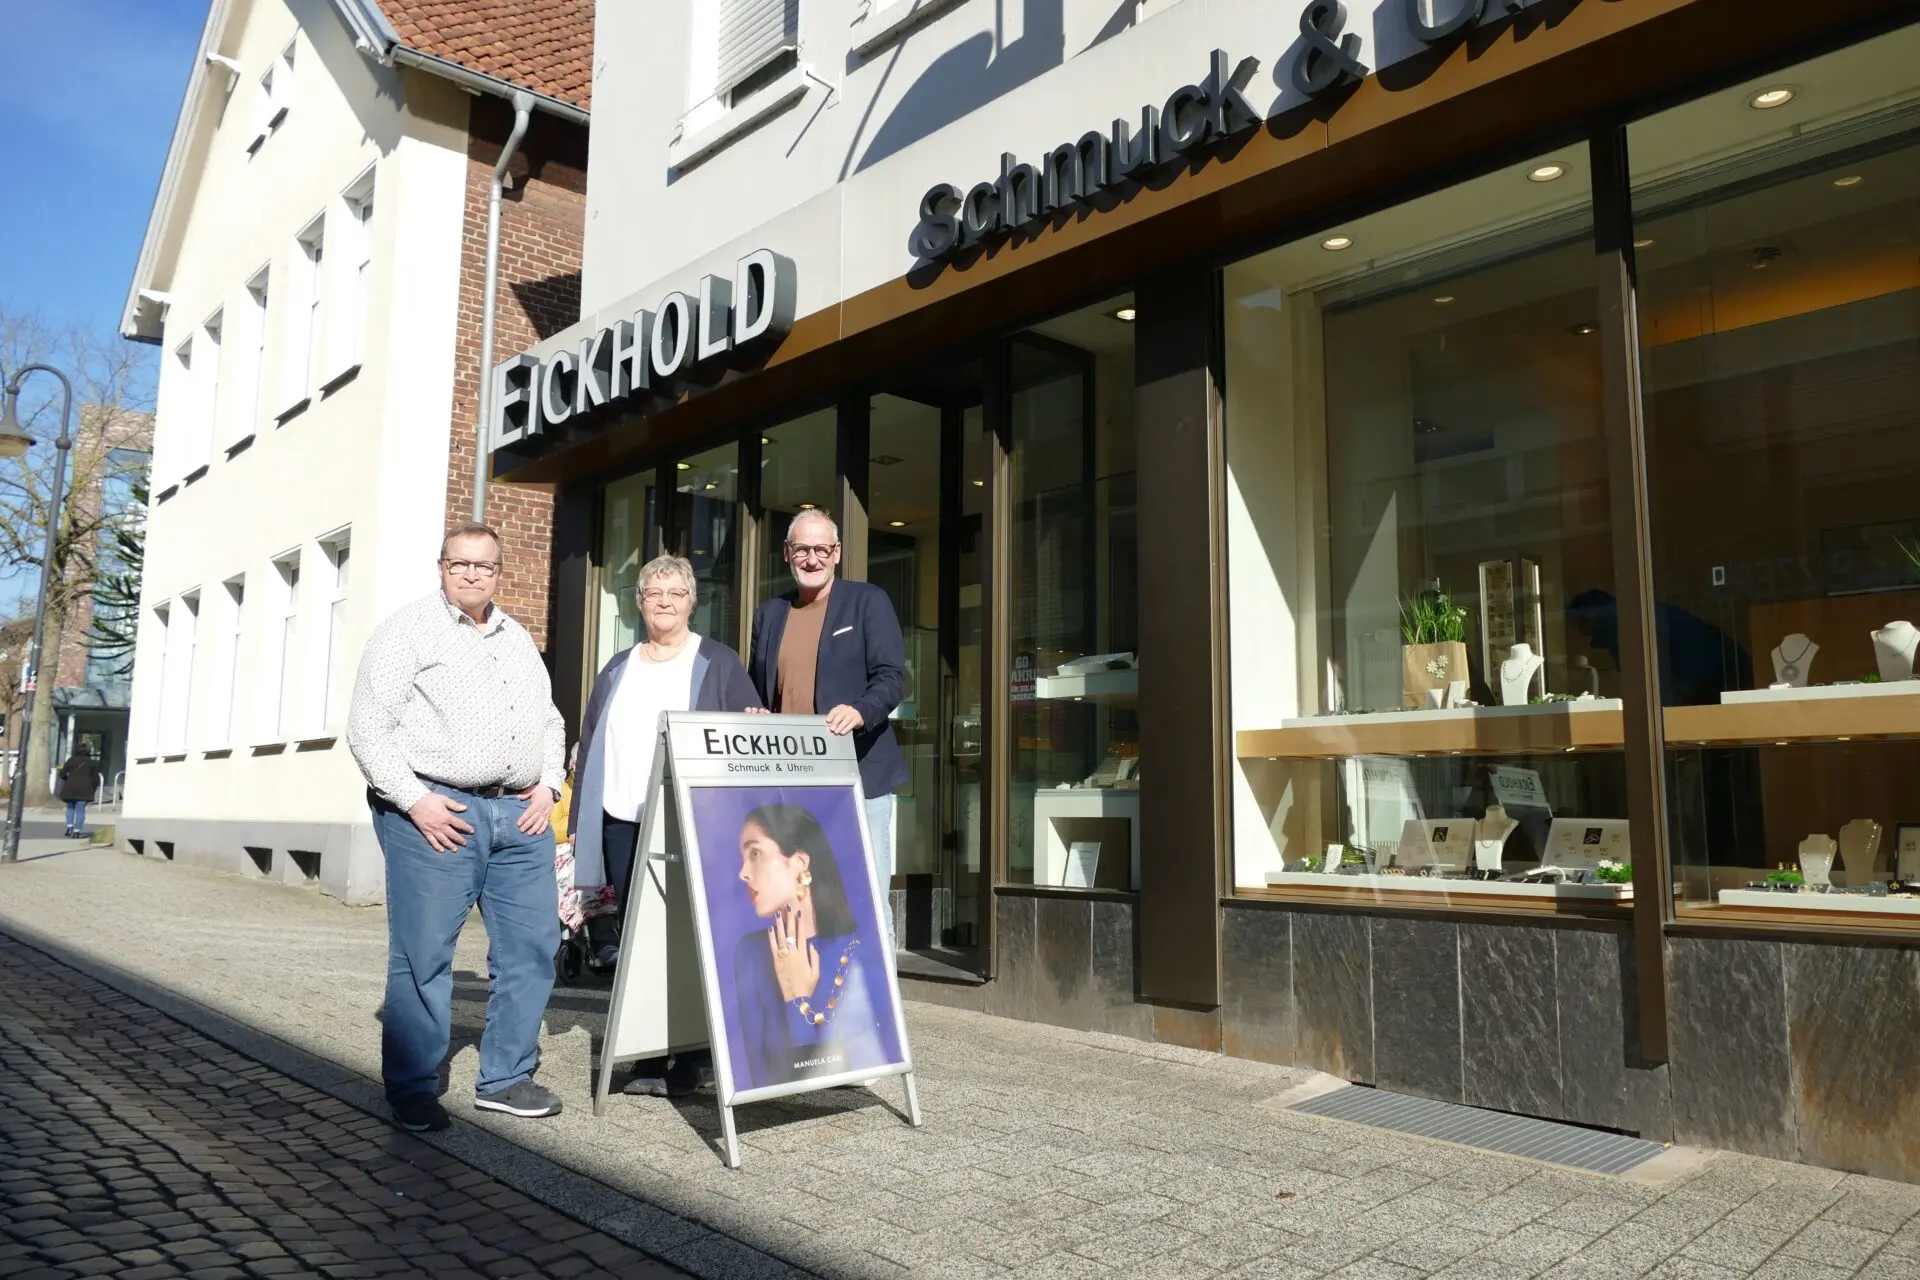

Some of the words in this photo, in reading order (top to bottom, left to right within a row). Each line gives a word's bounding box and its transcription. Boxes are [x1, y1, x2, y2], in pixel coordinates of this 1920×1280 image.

[916, 48, 1263, 260] Schmuck
[1292, 0, 1370, 95] &
[488, 248, 798, 453] EICKHOLD
[703, 728, 827, 756] EICKHOLD
[728, 763, 770, 773] Schmuck
[775, 763, 782, 772] &
[787, 763, 814, 773] Uhren
[793, 1057, 826, 1068] MANUELA
